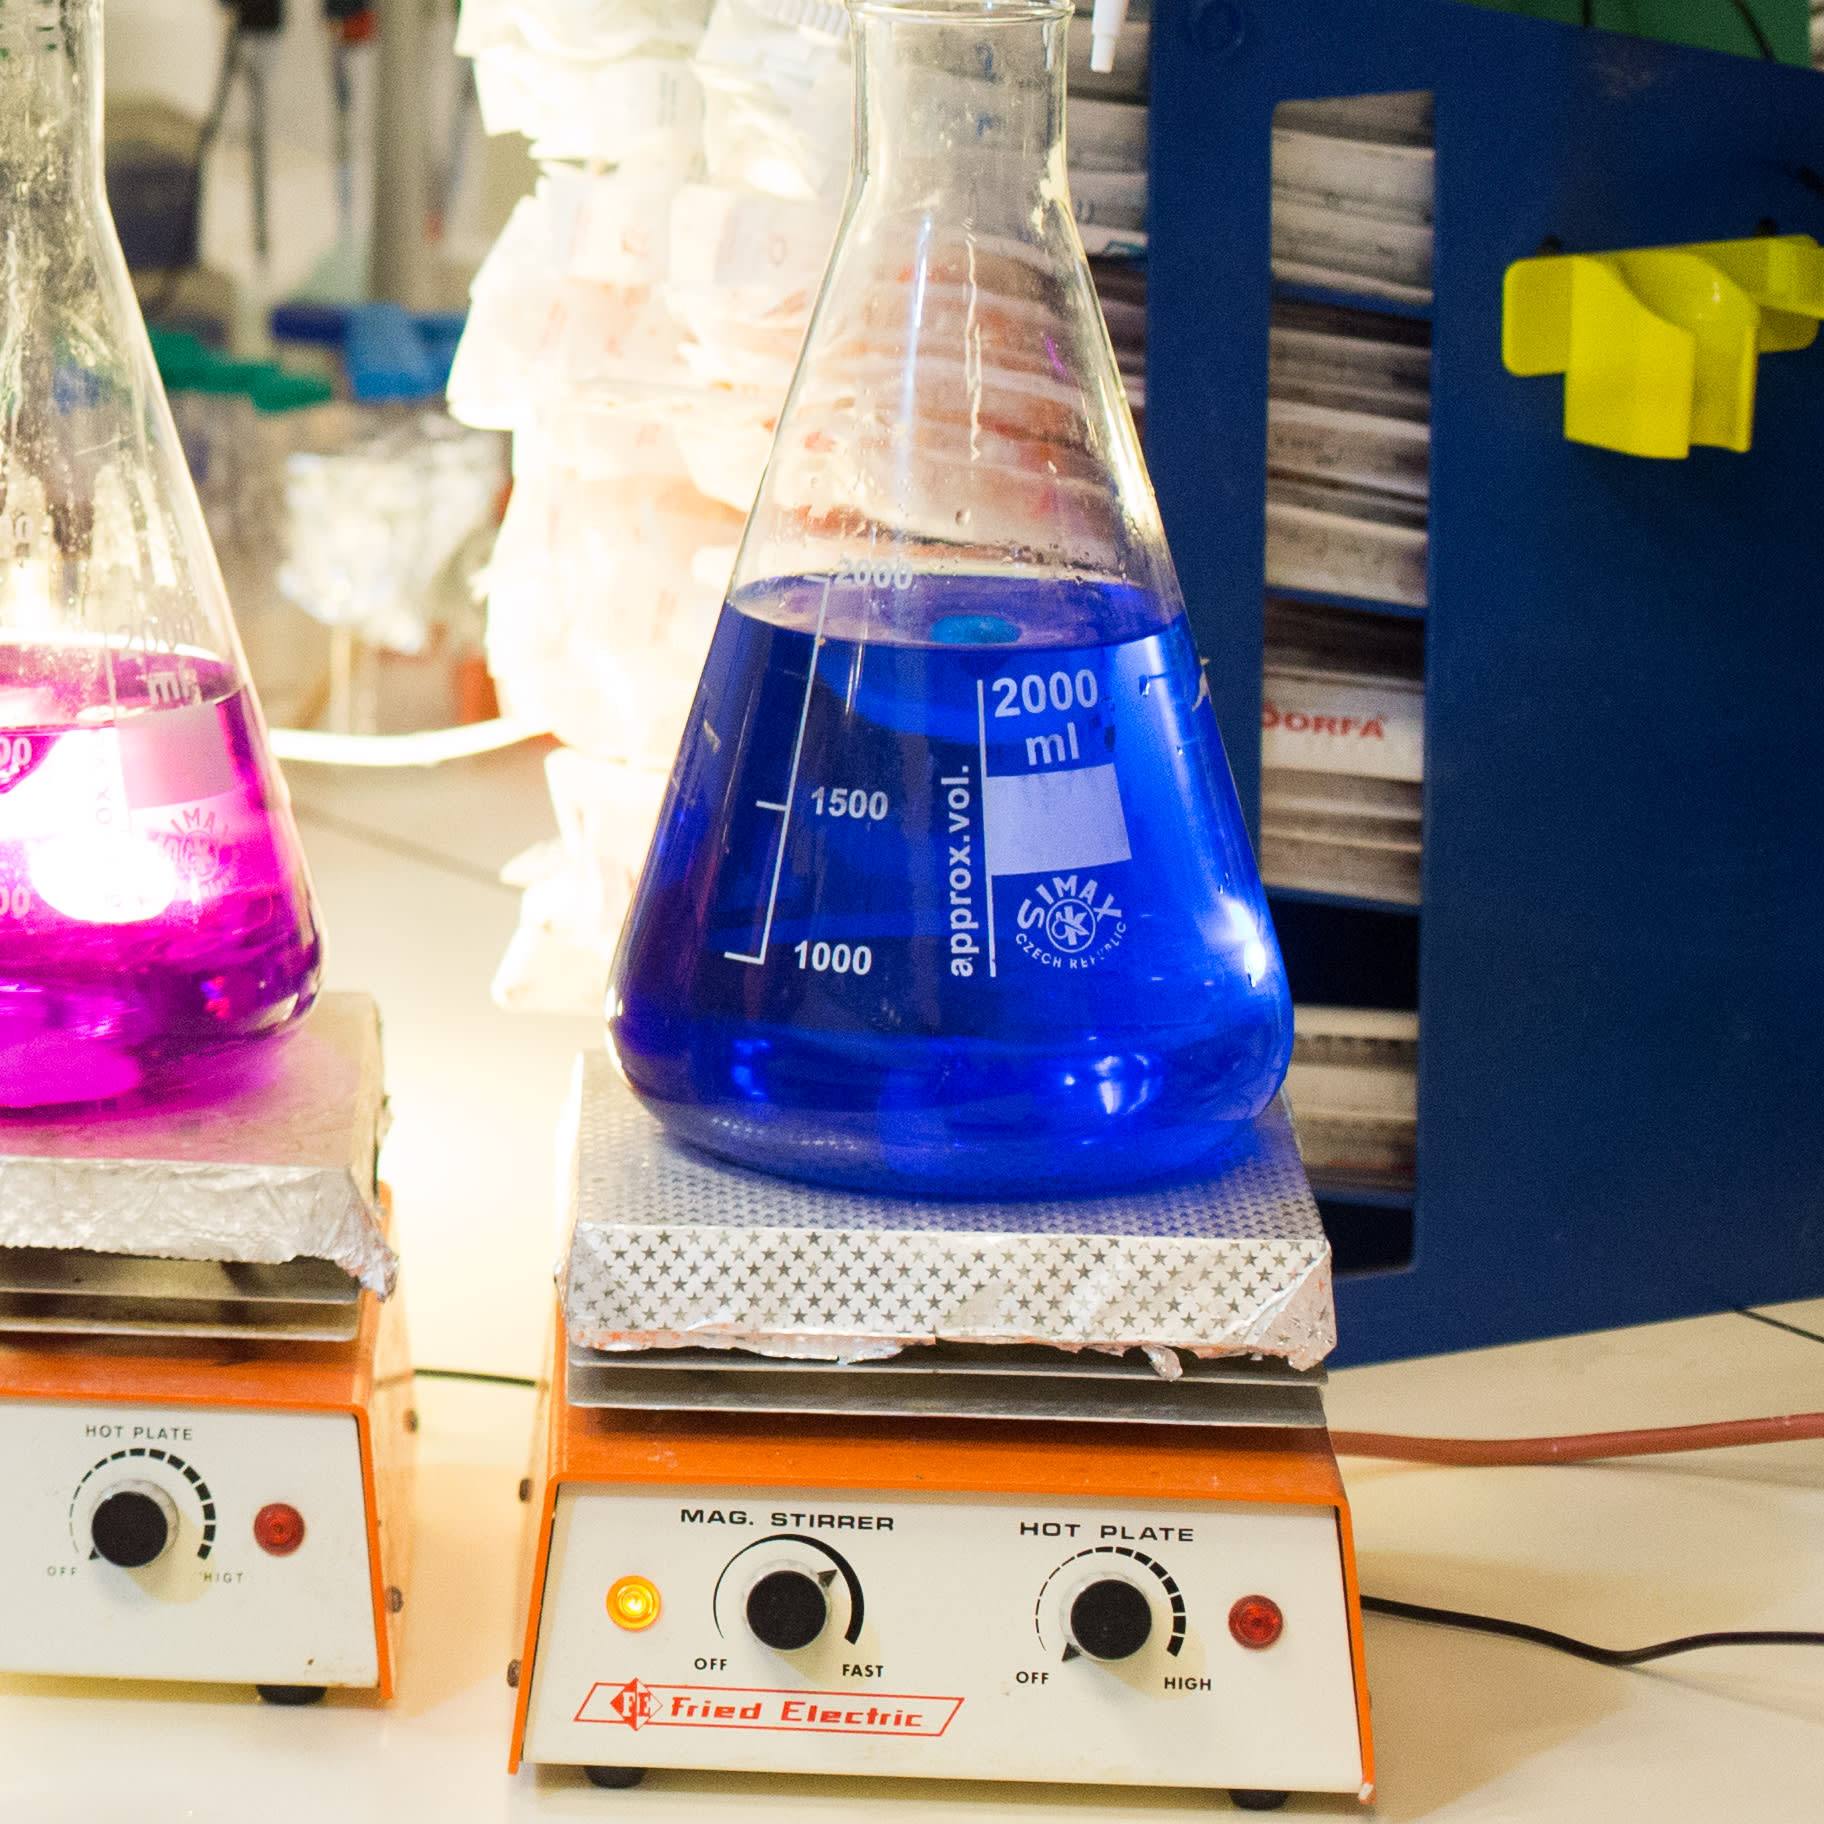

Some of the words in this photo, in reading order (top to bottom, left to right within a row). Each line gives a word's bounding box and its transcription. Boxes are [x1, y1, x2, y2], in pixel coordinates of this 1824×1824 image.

[834, 552, 914, 592] 2000
[992, 669, 1099, 718] 2000
[1026, 722, 1081, 766] ml
[809, 787, 889, 821] 1500
[941, 766, 979, 977] approx.vol.
[1016, 874, 1123, 930] SIMAX
[793, 942, 873, 976] 1000
[1015, 932, 1063, 969] CZECH
[85, 1425, 125, 1439] HOT
[133, 1426, 194, 1442] PLATE
[680, 1508, 755, 1526] MAG.
[770, 1511, 895, 1532] STIRRER
[1019, 1521, 1082, 1538] HOT
[1100, 1525, 1195, 1543] PLATE
[46, 1565, 79, 1578] OFF
[693, 1657, 728, 1673] OFF
[841, 1663, 885, 1679] FAST
[1015, 1670, 1050, 1685] OFF
[1163, 1676, 1213, 1692] HIGH
[669, 1694, 763, 1722] Fried
[780, 1699, 925, 1729] Electric
